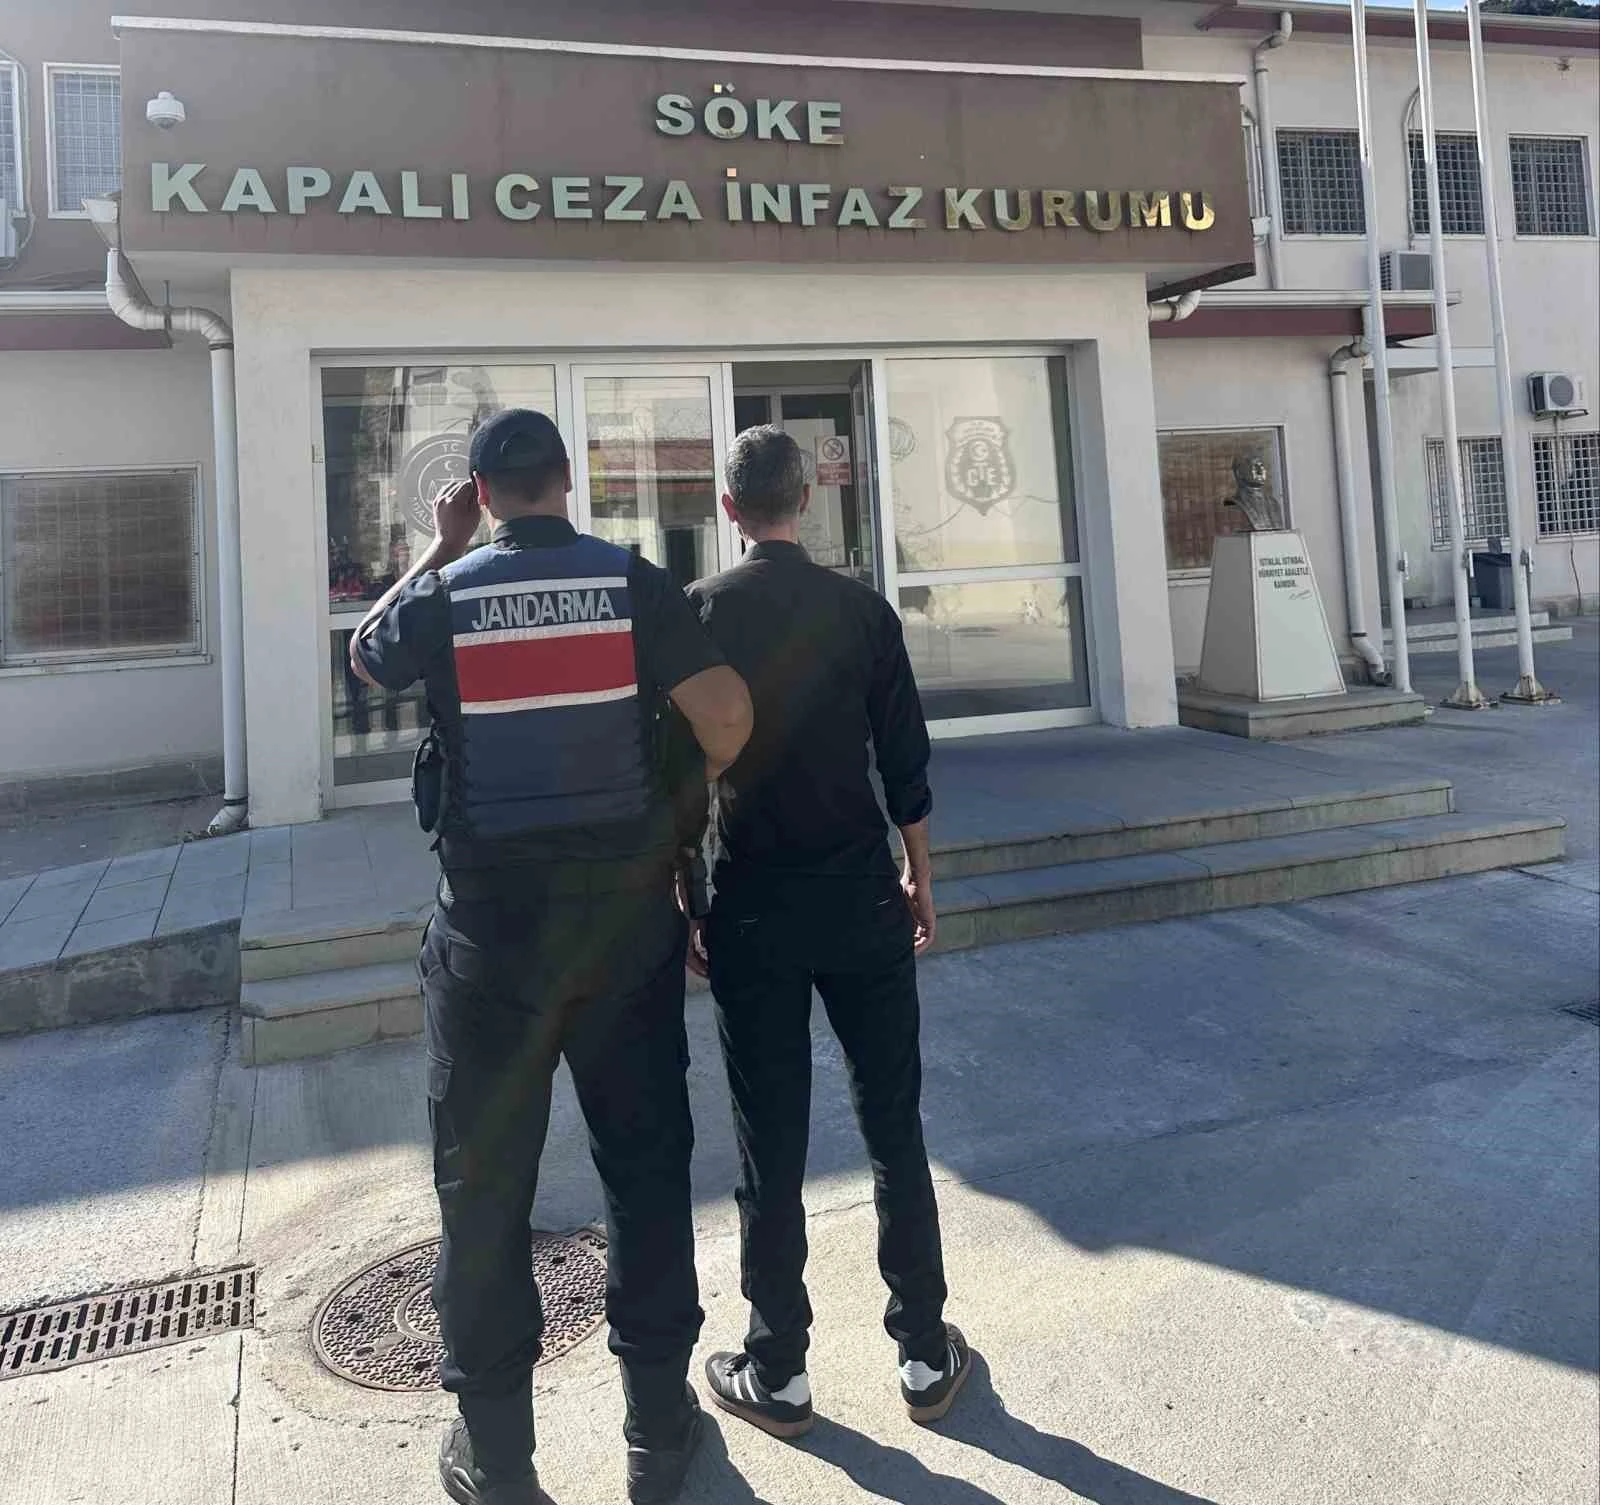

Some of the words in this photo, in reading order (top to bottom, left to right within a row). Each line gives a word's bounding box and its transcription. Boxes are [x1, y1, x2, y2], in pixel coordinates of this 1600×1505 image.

[656, 83, 844, 145] SÖKE
[150, 162, 470, 221] KAPALI
[495, 173, 703, 221] CEZA
[726, 167, 927, 229] İNFAZ
[944, 187, 1215, 231] KURUMU
[471, 589, 616, 631] JANDARMA
